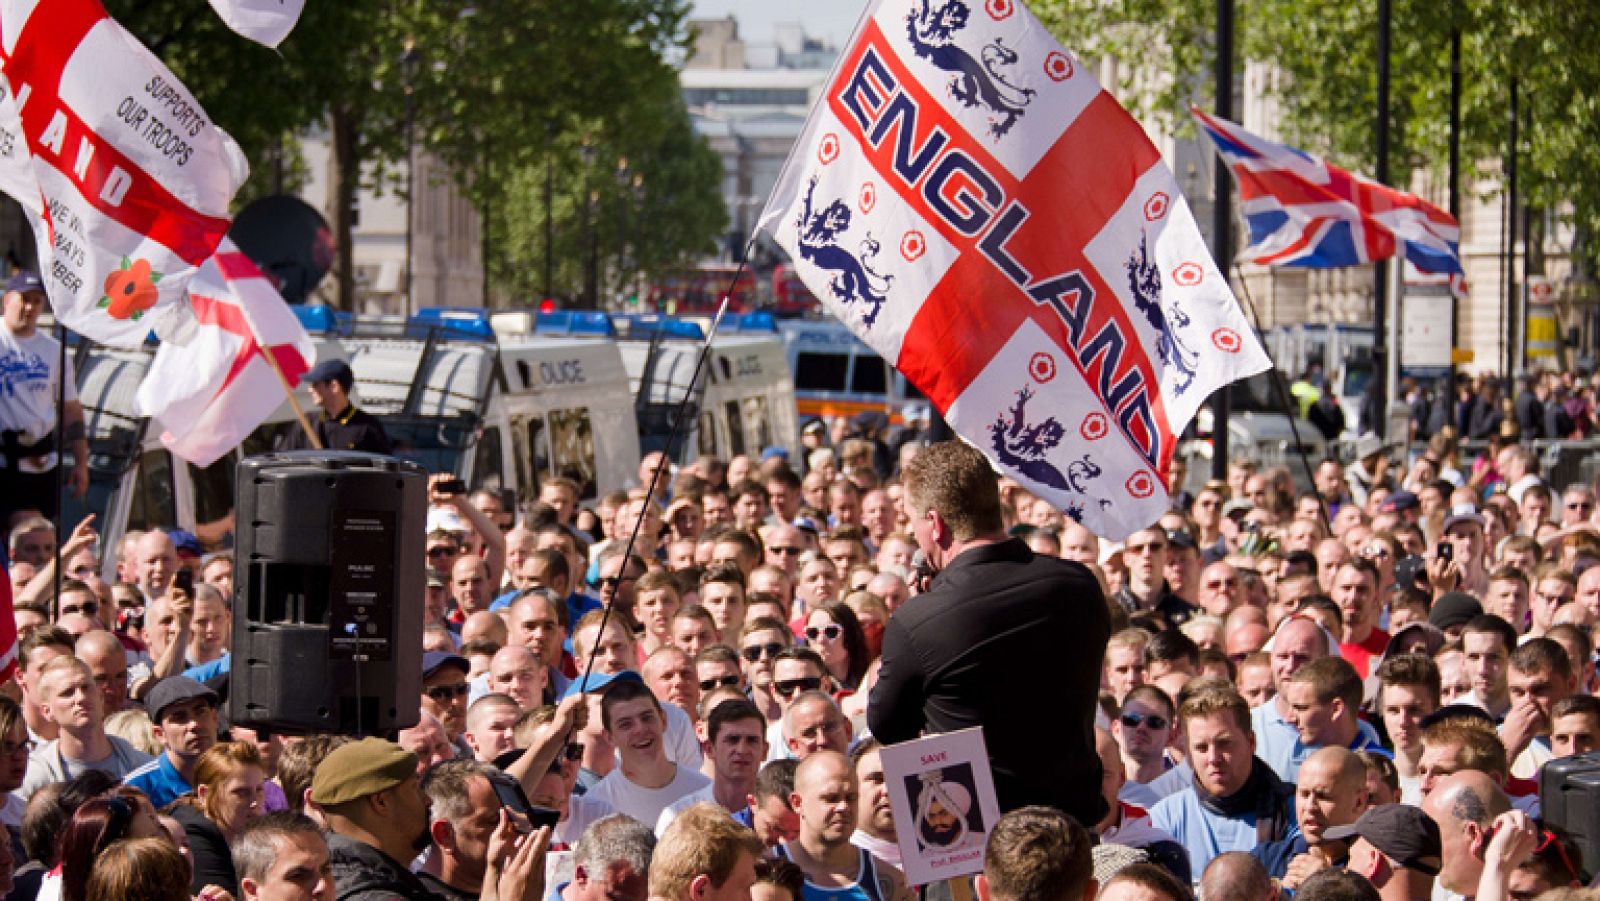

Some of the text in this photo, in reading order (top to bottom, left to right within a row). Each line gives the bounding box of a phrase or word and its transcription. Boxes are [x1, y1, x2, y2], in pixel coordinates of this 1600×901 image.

[145, 74, 206, 137] SUPPORTS
[116, 96, 194, 167] OUR TROOPS
[54, 231, 84, 268] WAYS
[840, 43, 1159, 468] ENGLAND
[537, 359, 586, 385] OLICE
[920, 751, 947, 766] SAVE
